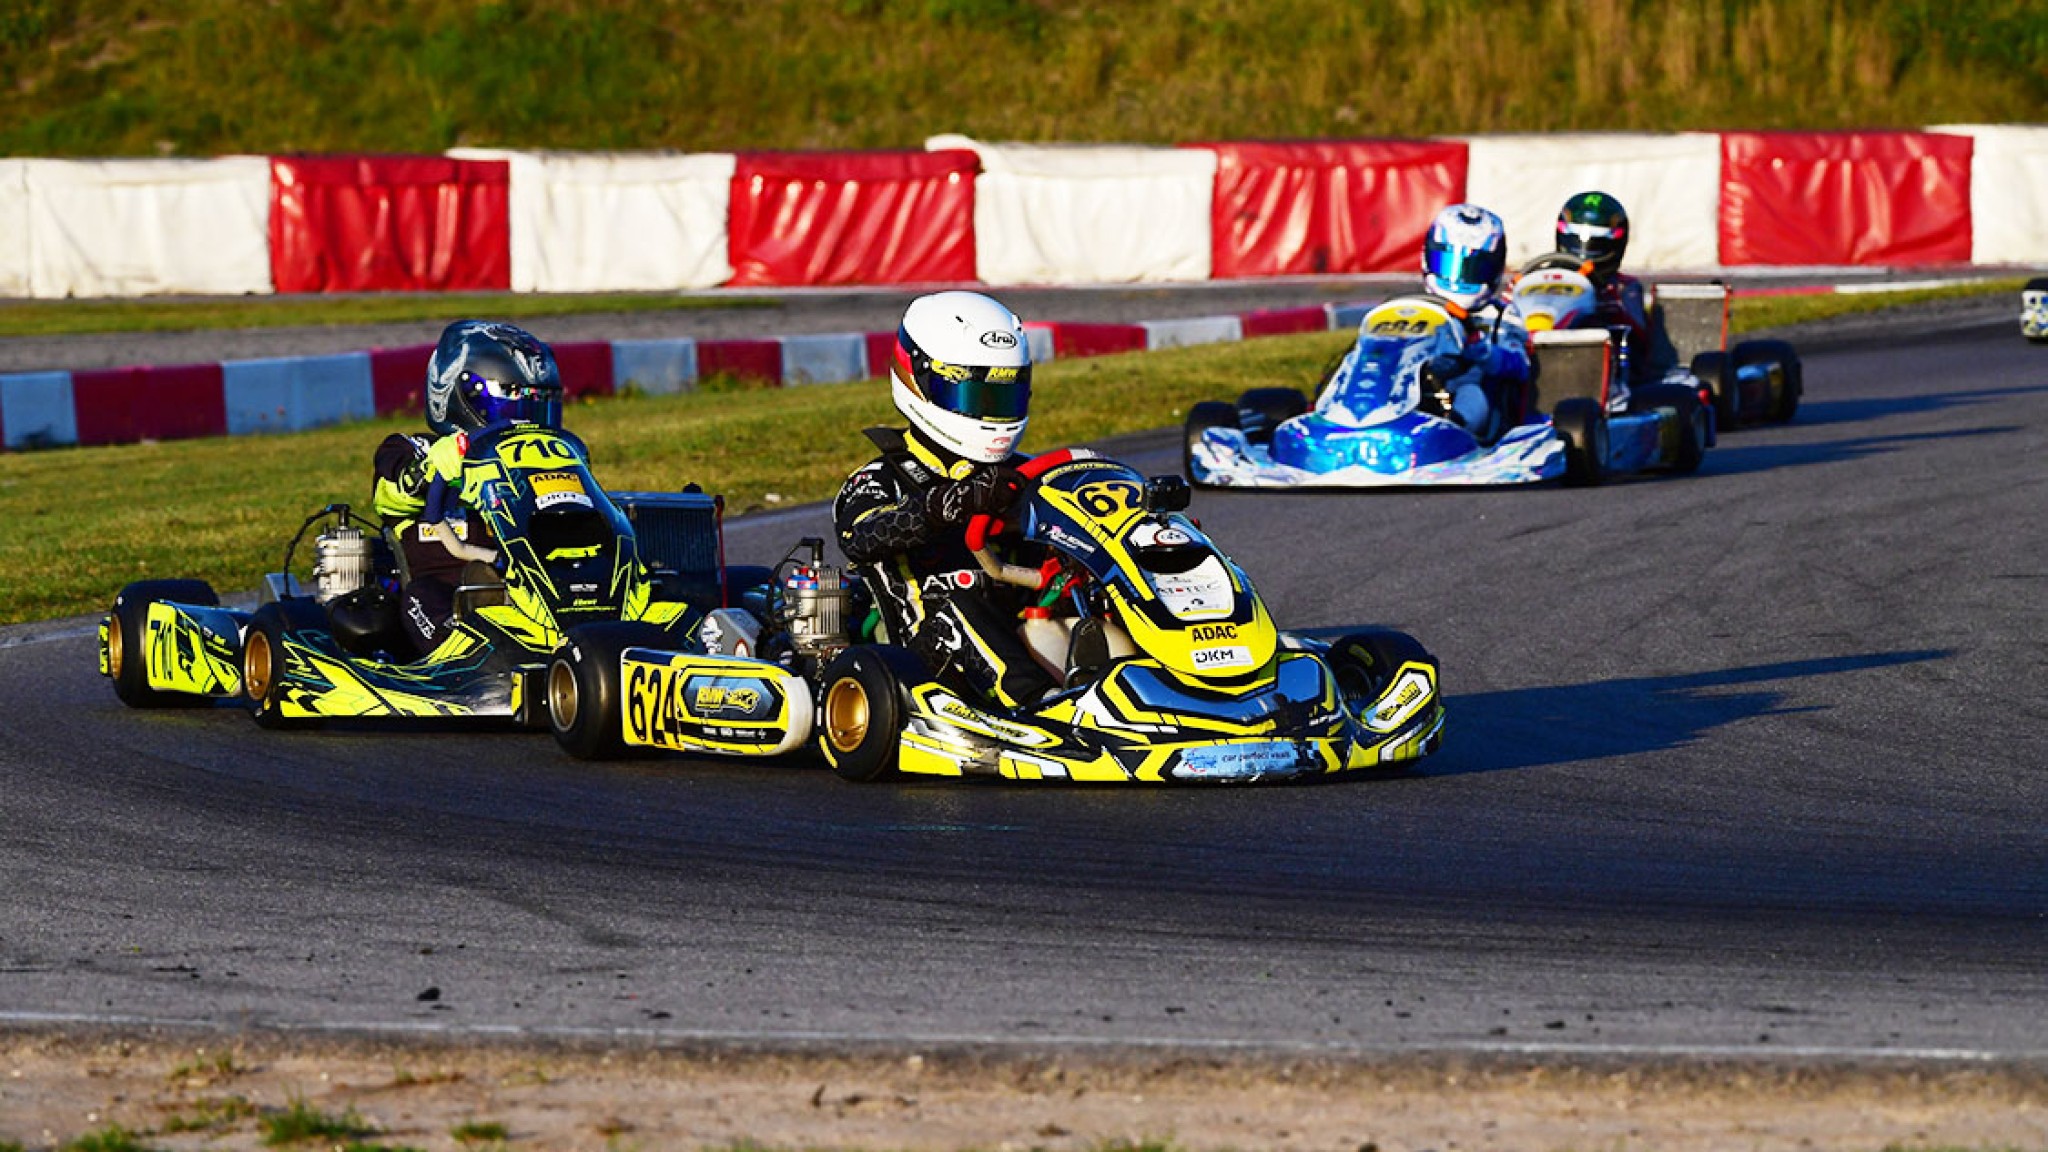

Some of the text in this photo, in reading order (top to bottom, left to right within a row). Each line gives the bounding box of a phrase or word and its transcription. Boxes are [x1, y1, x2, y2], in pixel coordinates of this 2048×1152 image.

[500, 438, 573, 463] 710
[1192, 625, 1239, 643] ADAC
[629, 664, 680, 745] 624
